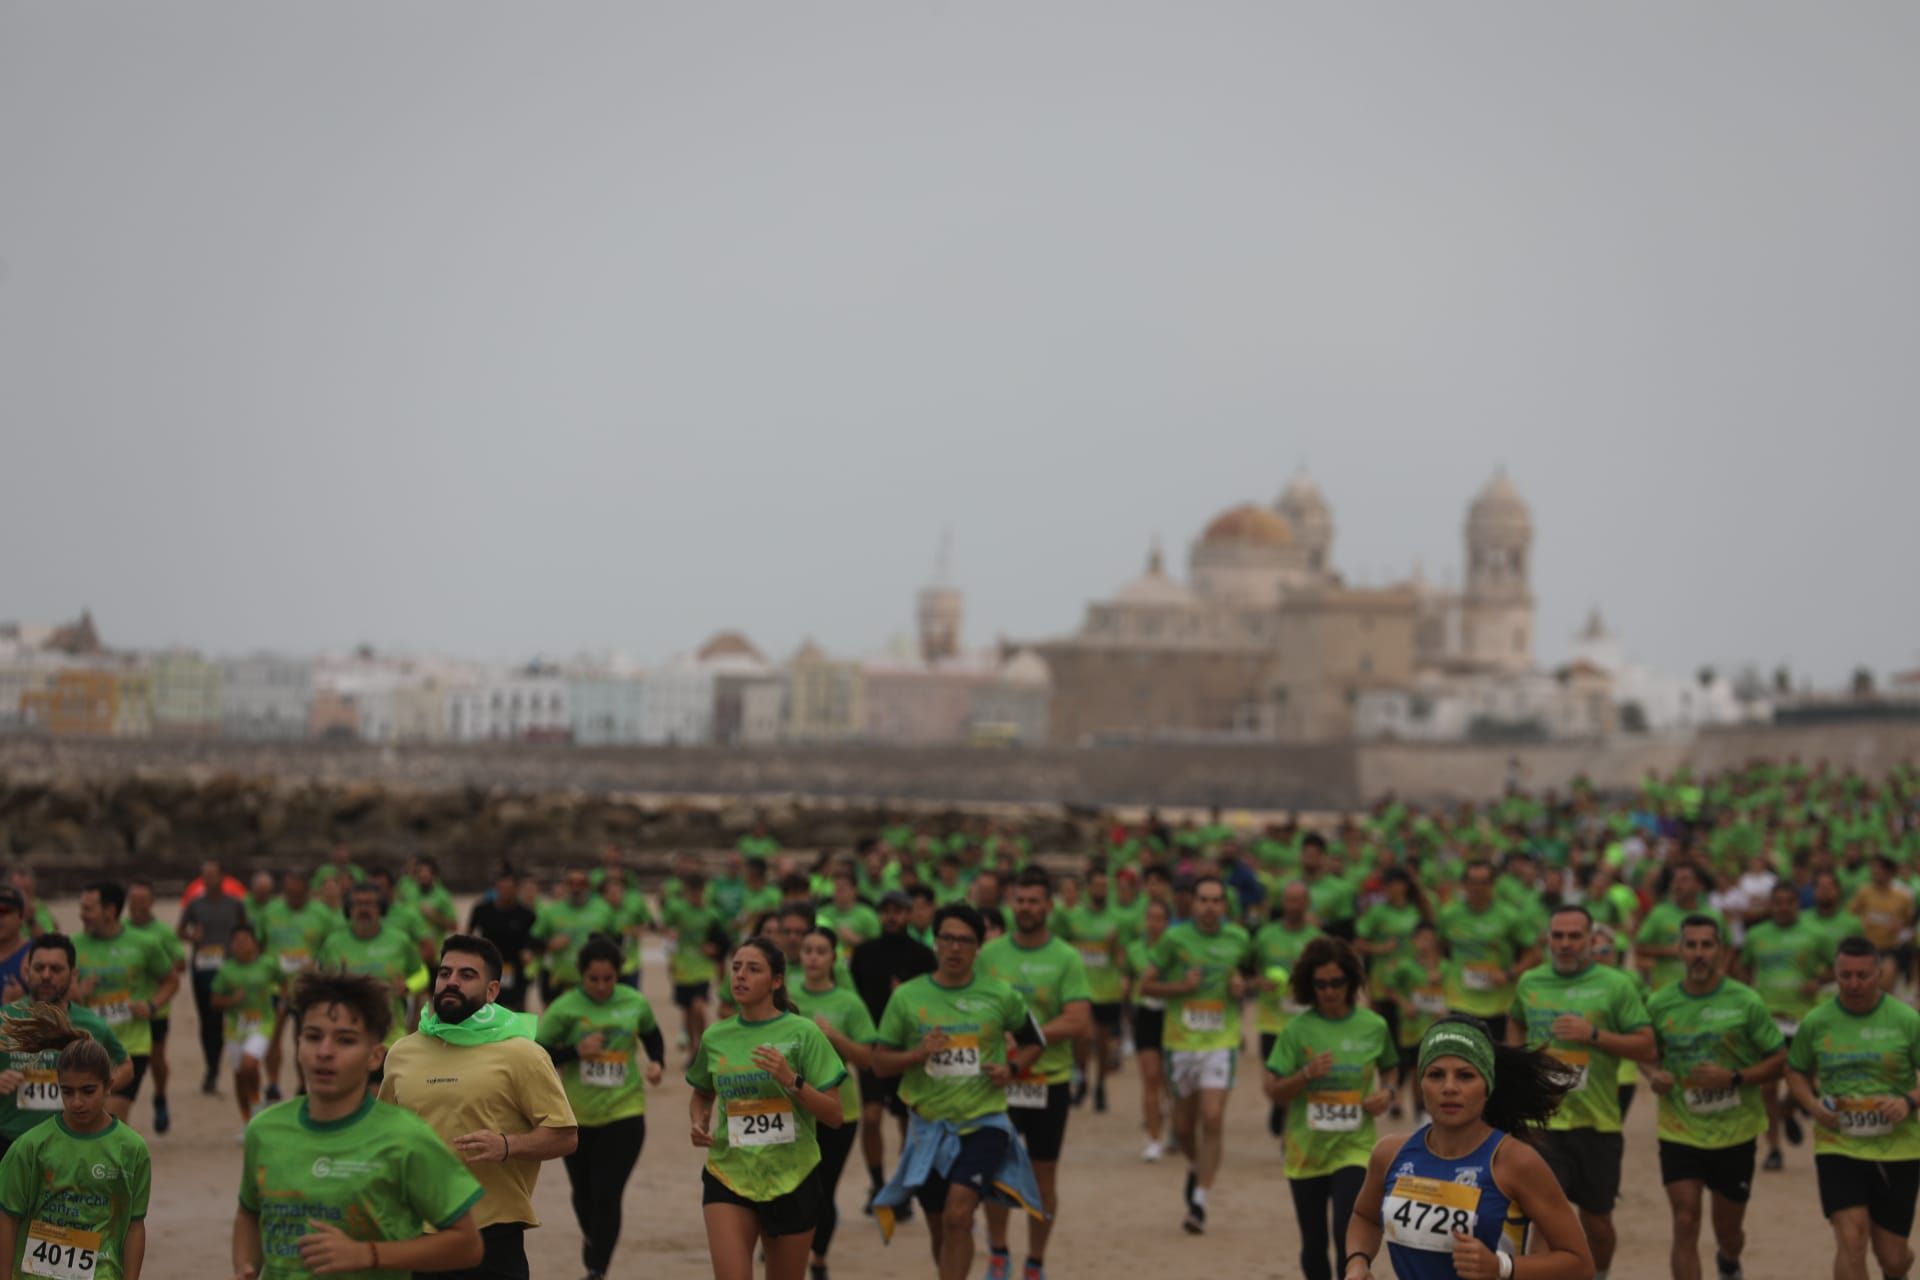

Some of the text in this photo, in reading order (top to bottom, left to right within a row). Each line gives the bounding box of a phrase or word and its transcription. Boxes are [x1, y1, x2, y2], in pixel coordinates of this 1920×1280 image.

[742, 1112, 785, 1135] 294
[1393, 1199, 1470, 1236] 4728
[32, 1240, 95, 1271] 4015
